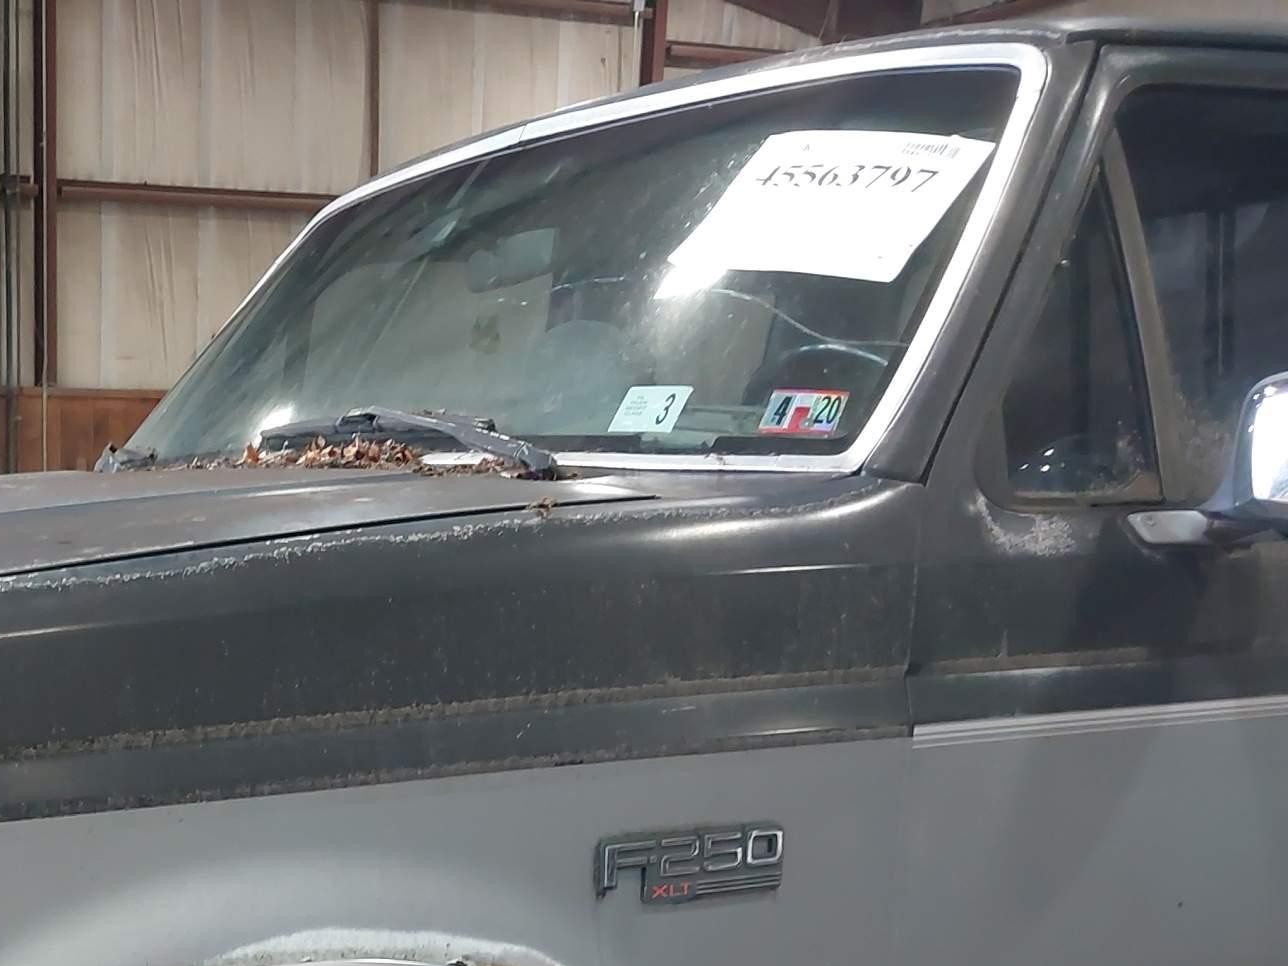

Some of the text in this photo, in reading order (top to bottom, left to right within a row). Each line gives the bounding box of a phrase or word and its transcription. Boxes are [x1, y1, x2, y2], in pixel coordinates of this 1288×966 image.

[655, 393, 677, 425] 3
[773, 396, 842, 425] 4 20
[651, 881, 692, 899] XLT
